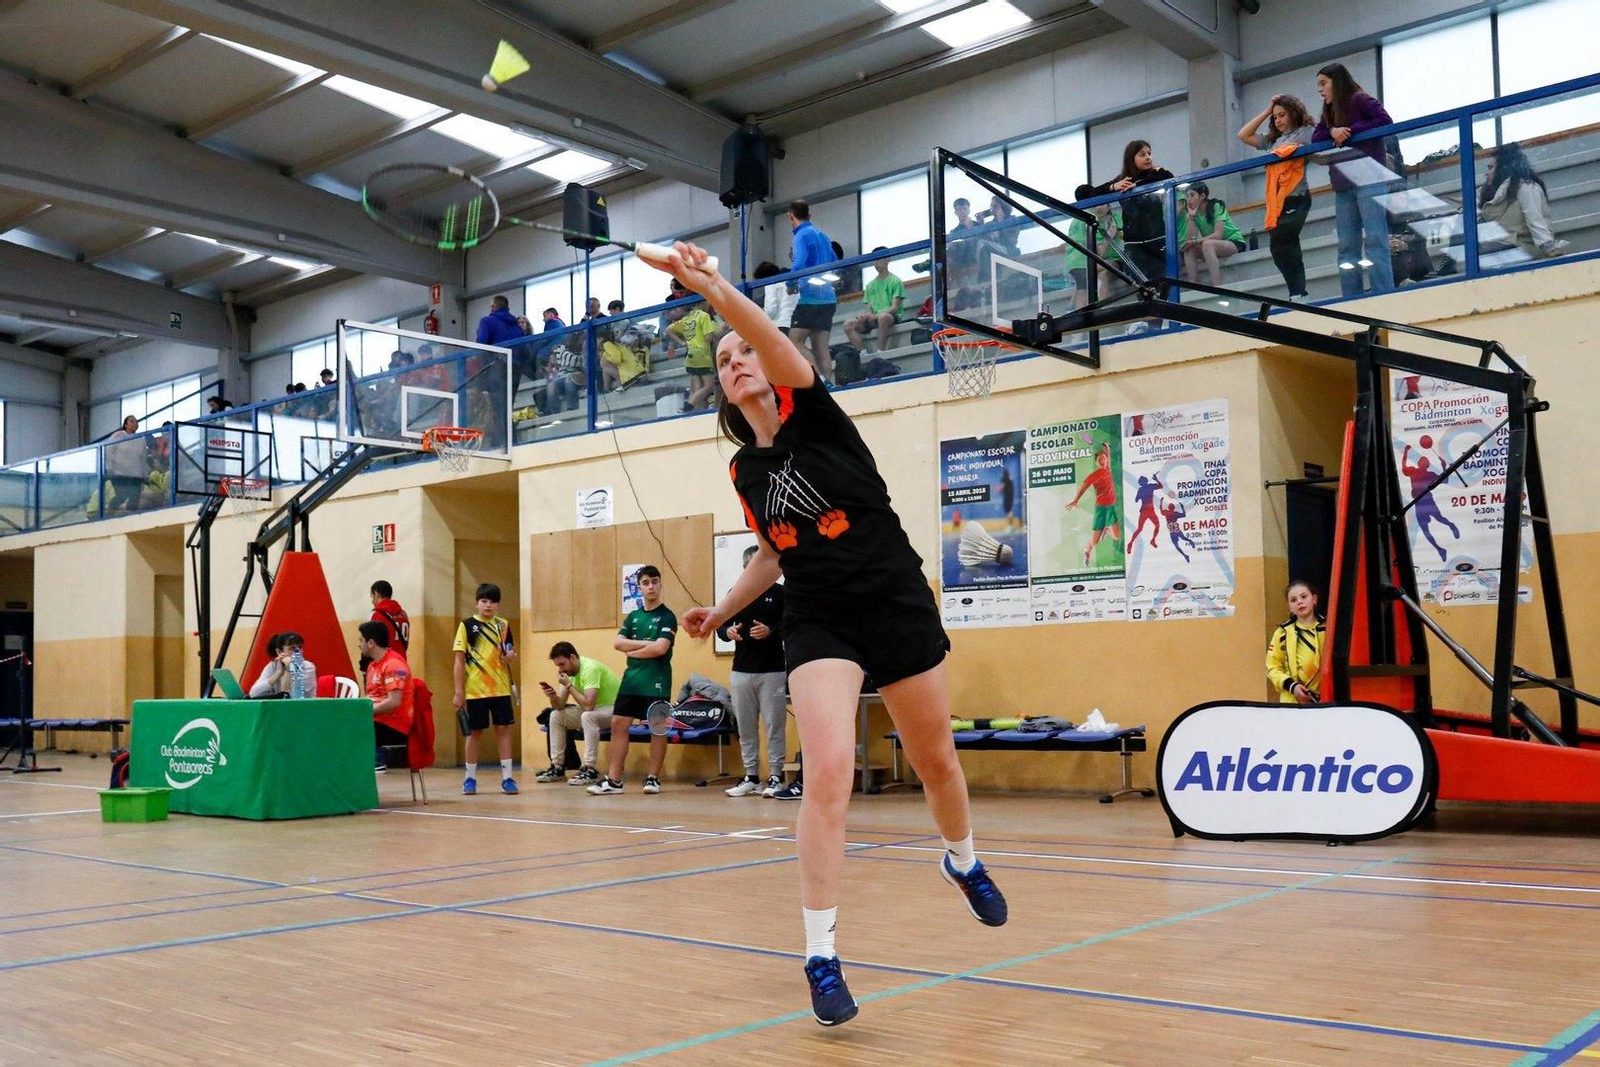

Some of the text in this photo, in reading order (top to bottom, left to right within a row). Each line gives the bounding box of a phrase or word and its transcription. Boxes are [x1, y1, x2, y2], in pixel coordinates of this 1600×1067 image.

[1401, 394, 1490, 413] COPA Promoción
[1480, 405, 1508, 418] Xoga
[1030, 420, 1097, 438] CAMPIONATO
[1496, 428, 1509, 436] FIN
[1031, 437, 1074, 450] ESCOLAR
[1129, 431, 1198, 448] COPA Promoción
[1191, 437, 1225, 452] Xogade
[1497, 438, 1509, 446] CO
[948, 445, 1015, 461] CAMPIONATO ESCOLAR
[1031, 448, 1092, 464] PROVINCIAL
[948, 459, 1004, 473] ZONAL INDIVIDUAL
[1204, 460, 1226, 469] FINAL
[1464, 458, 1508, 469] BADMINT
[1053, 467, 1072, 475] MAIO
[1204, 468, 1227, 477] COPA
[948, 474, 978, 484] PRIMARIA
[1178, 487, 1228, 498] BADMINTON
[1194, 495, 1228, 505] XOGADE
[1451, 496, 1466, 507] 20
[1471, 494, 1486, 505] DE
[1183, 521, 1196, 531] DE
[1199, 518, 1227, 530] MAIO
[672, 708, 706, 717] ARTENGO
[161, 745, 206, 758] Club Badminton
[169, 758, 213, 774] Ponteareas
[1174, 748, 1413, 794] Atlántico
